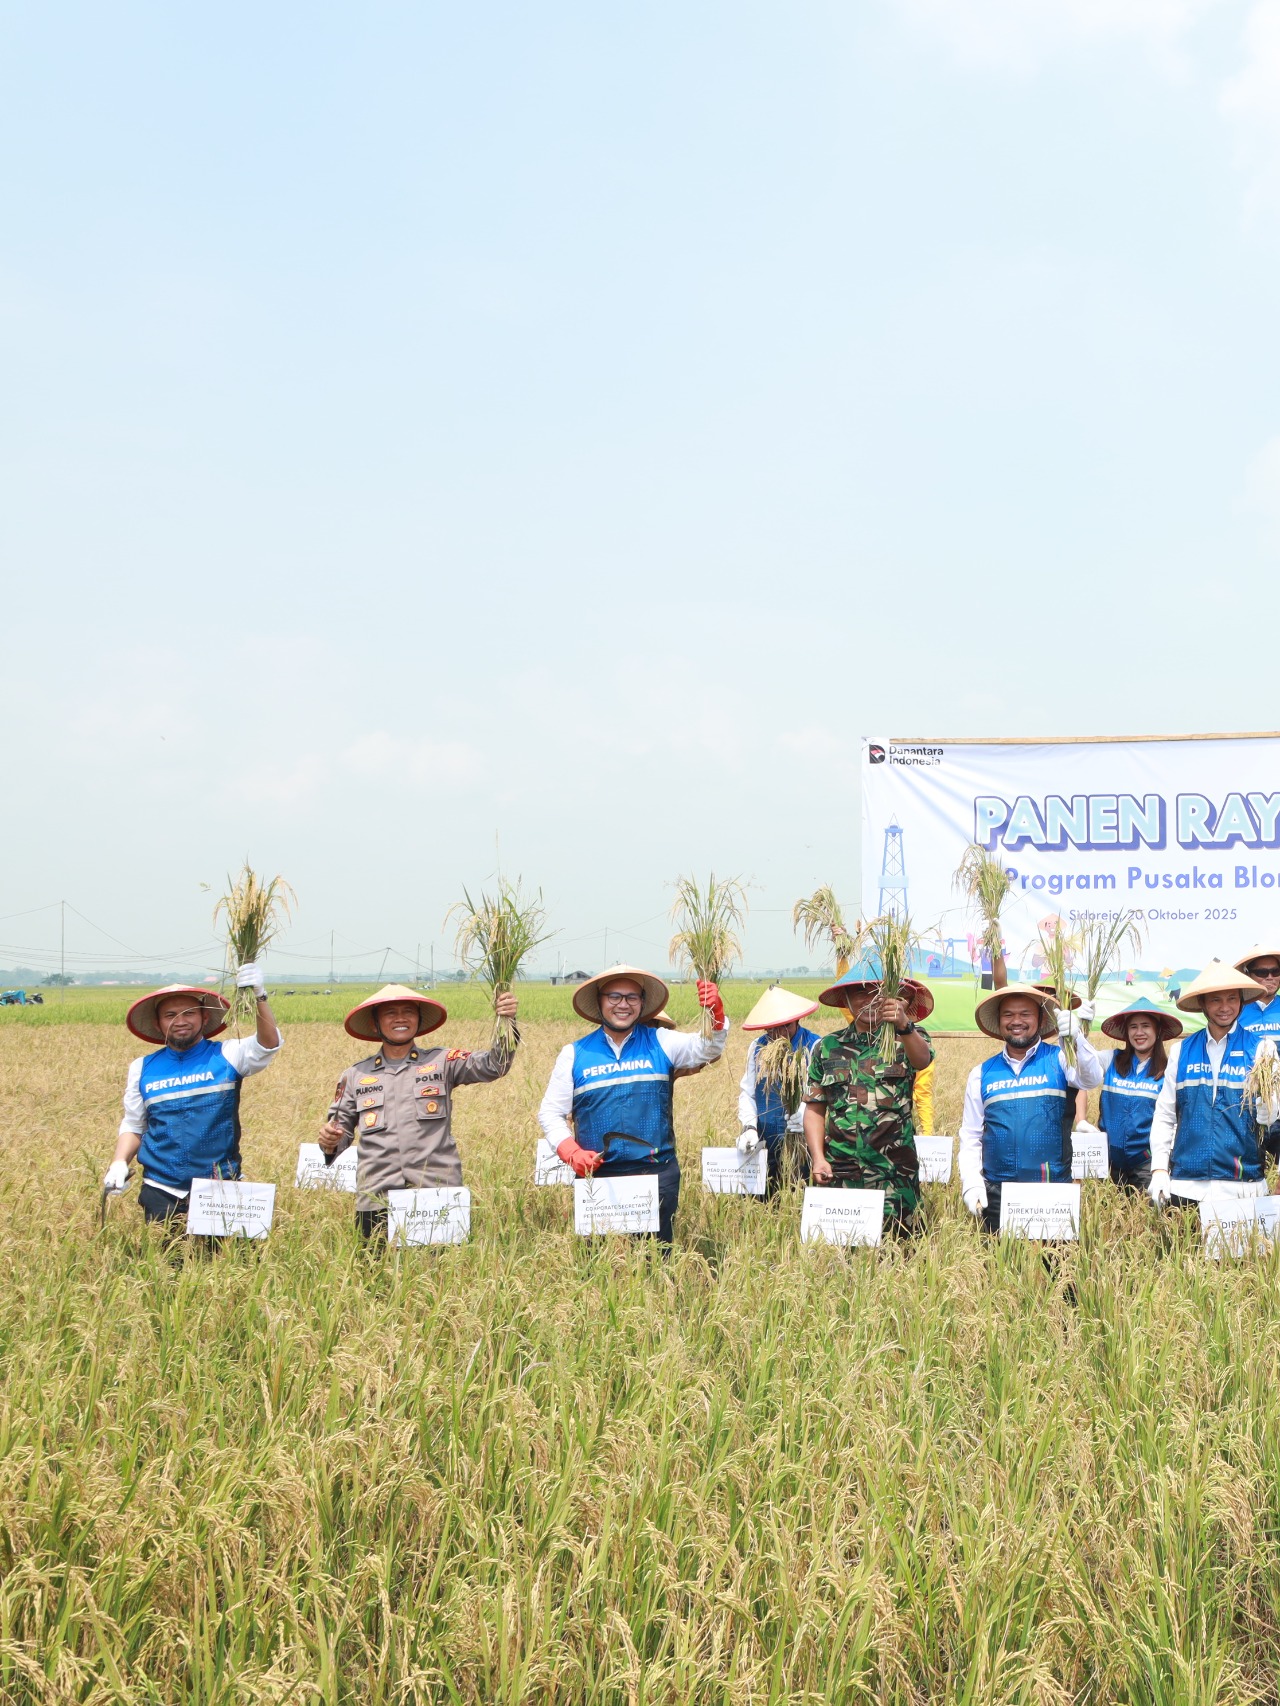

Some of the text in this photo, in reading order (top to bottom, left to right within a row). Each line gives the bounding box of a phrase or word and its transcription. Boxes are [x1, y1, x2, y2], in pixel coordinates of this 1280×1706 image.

[889, 746, 943, 755] Danantara
[889, 756, 940, 766] Indonesia
[974, 794, 1166, 851] PANEN
[1005, 867, 1116, 895] Program
[1128, 866, 1223, 890] Pusaka
[1129, 909, 1144, 920] 20
[1148, 909, 1199, 920] Oktober
[1204, 909, 1237, 920] 2025
[583, 1060, 653, 1078] PERTAMINA
[1187, 1063, 1246, 1076] PERTAMINA
[145, 1071, 215, 1093] PERTAMINA
[416, 1073, 443, 1083] POLRI
[986, 1074, 1048, 1094] PERTAMINA
[1112, 1077, 1159, 1092] PERTAMINA
[825, 1208, 861, 1216] DANDIM
